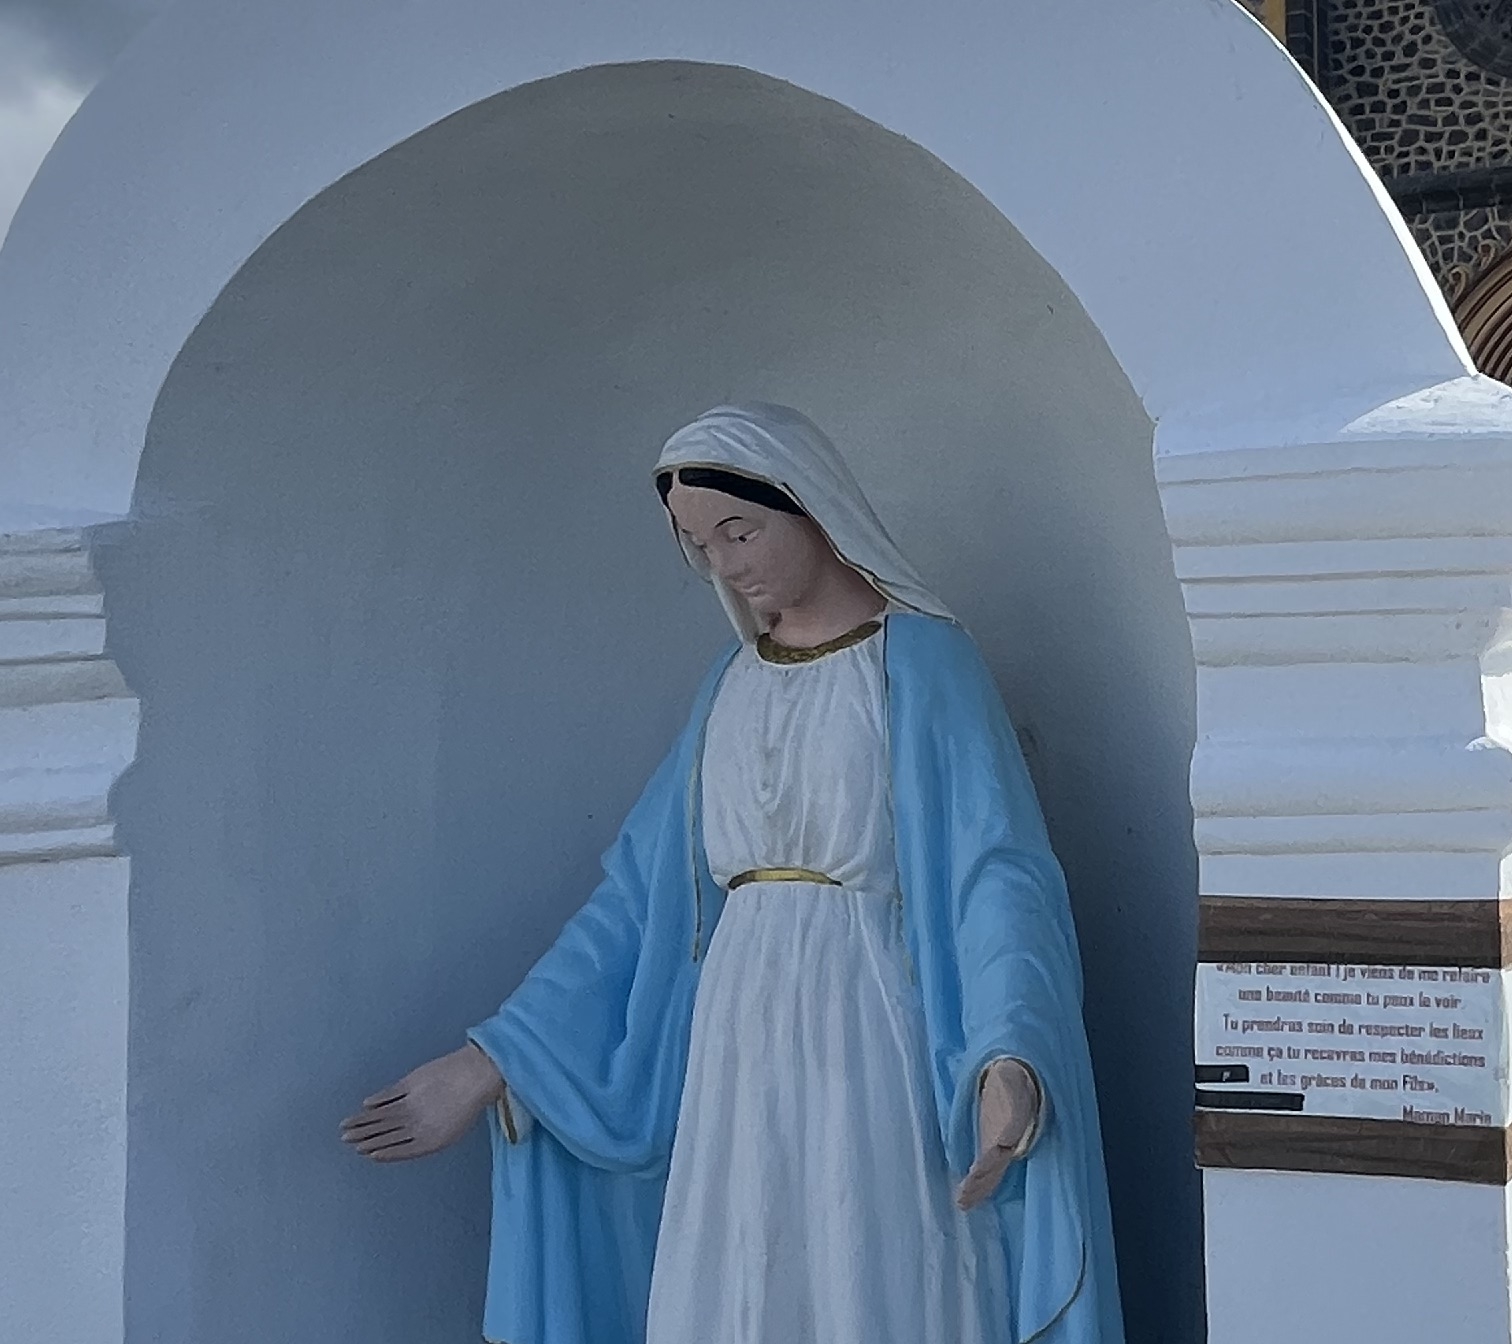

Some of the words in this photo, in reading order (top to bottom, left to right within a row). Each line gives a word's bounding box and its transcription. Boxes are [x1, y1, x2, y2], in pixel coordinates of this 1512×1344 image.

[1255, 963, 1287, 976] cher
[1360, 966, 1394, 979] viens
[1399, 966, 1414, 980] de
[1418, 969, 1438, 981] me
[1442, 967, 1490, 983] refaire
[1238, 989, 1262, 1002] une
[1266, 985, 1310, 1003] beauté
[1314, 992, 1361, 1005] comme
[1366, 992, 1379, 1005] tu
[1223, 1013, 1238, 1030] Tu
[1242, 1016, 1303, 1035] prendras
[1307, 1018, 1335, 1034] soin
[1338, 1018, 1353, 1035] de
[1358, 1023, 1425, 1039] respecter
[1429, 1021, 1449, 1038] les
[1453, 1022, 1483, 1040] lieux
[1215, 1045, 1264, 1058] comme
[1267, 1046, 1283, 1061] ça
[1287, 1046, 1300, 1059] tu
[1304, 1047, 1365, 1062] recevras
[1369, 1051, 1396, 1064] mes
[1400, 1047, 1486, 1067] bénédictions
[1260, 1071, 1273, 1085] et
[1276, 1069, 1296, 1086] les
[1300, 1072, 1346, 1090] grâces
[1350, 1072, 1366, 1090] de
[1369, 1077, 1398, 1090] mon
[1454, 1106, 1492, 1126] Marie
